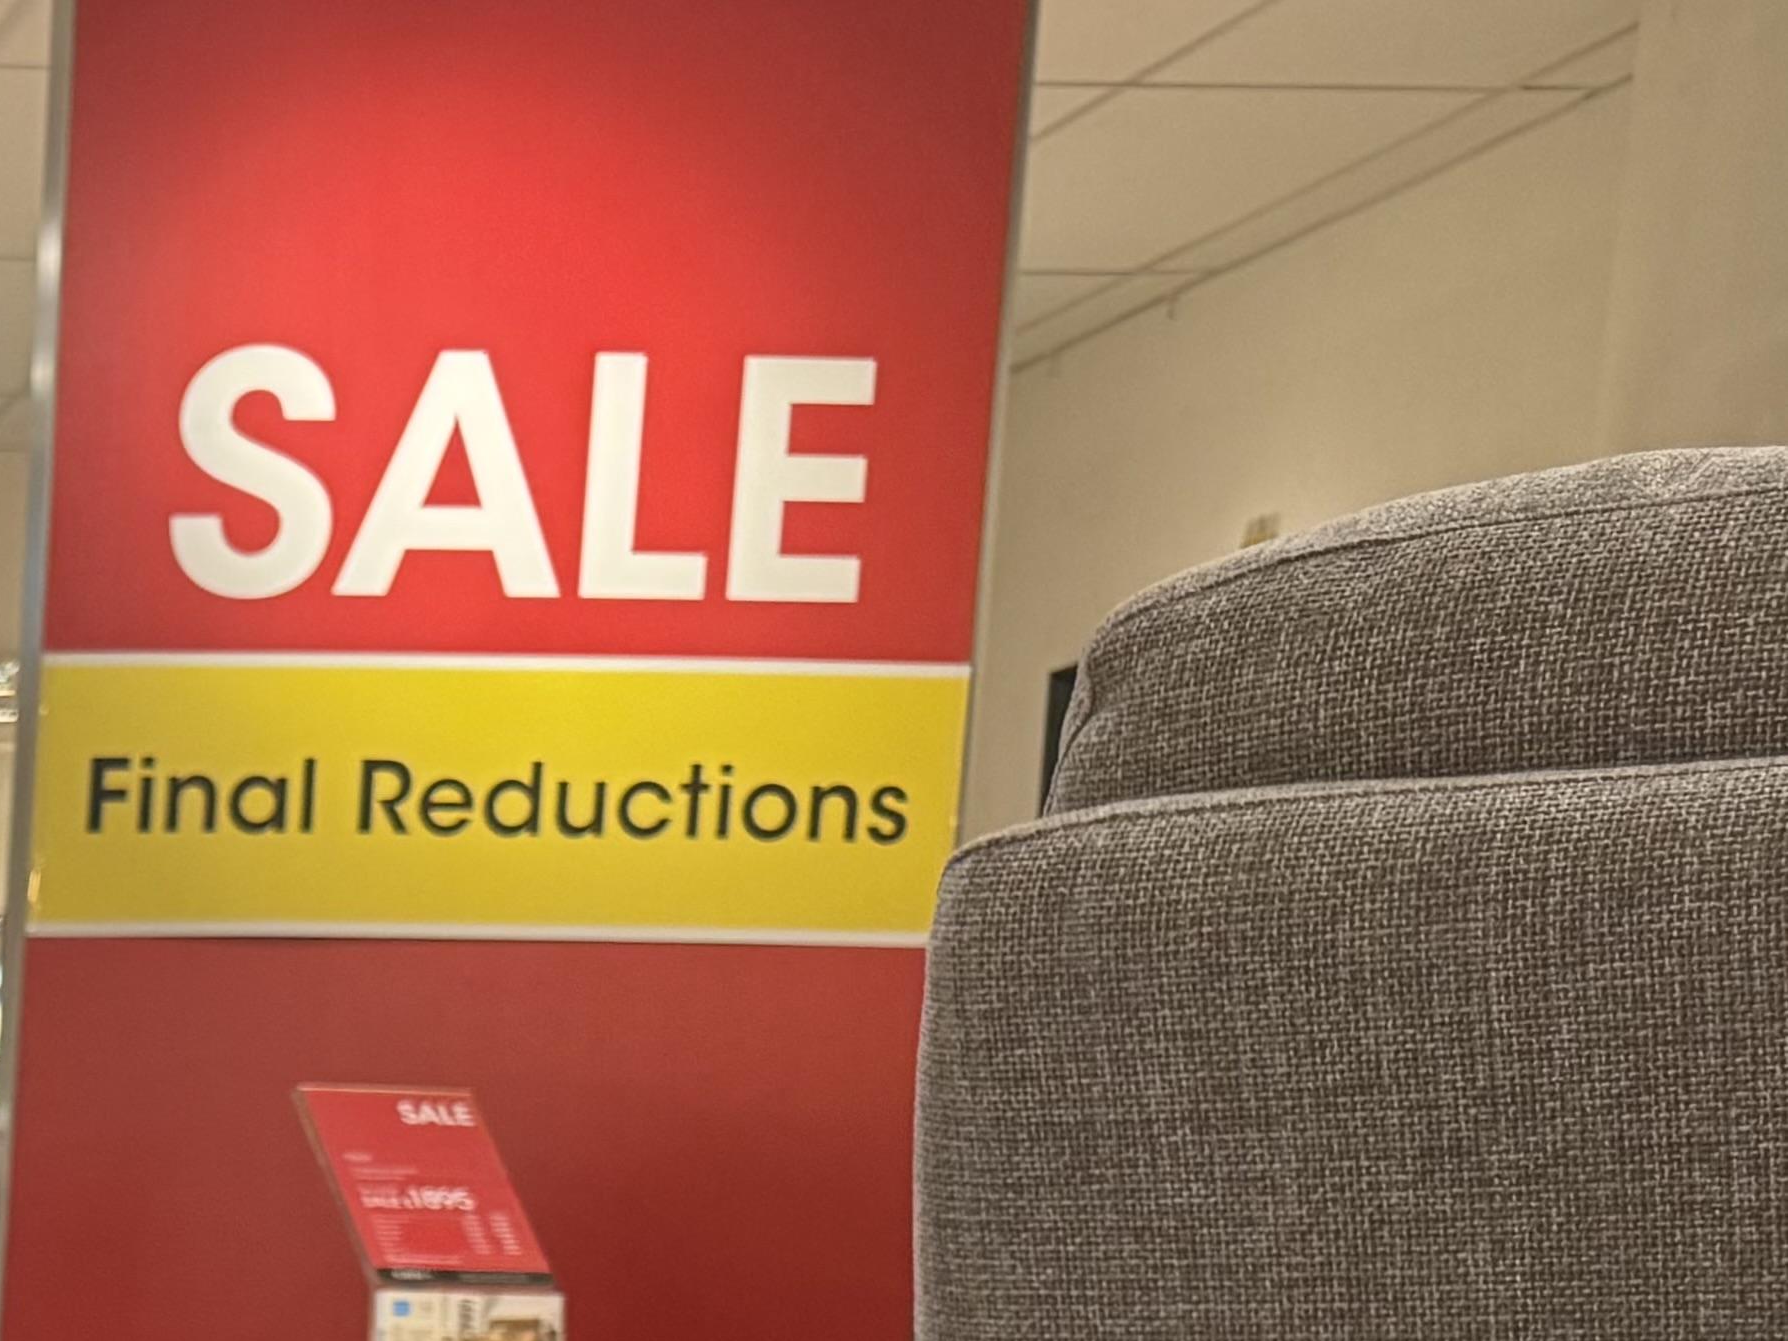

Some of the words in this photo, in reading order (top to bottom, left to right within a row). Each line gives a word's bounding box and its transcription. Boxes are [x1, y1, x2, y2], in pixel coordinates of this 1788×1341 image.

[169, 343, 877, 603] SALE
[85, 755, 317, 836] Final
[357, 758, 909, 846] Reductions
[396, 1099, 476, 1127] SALE
